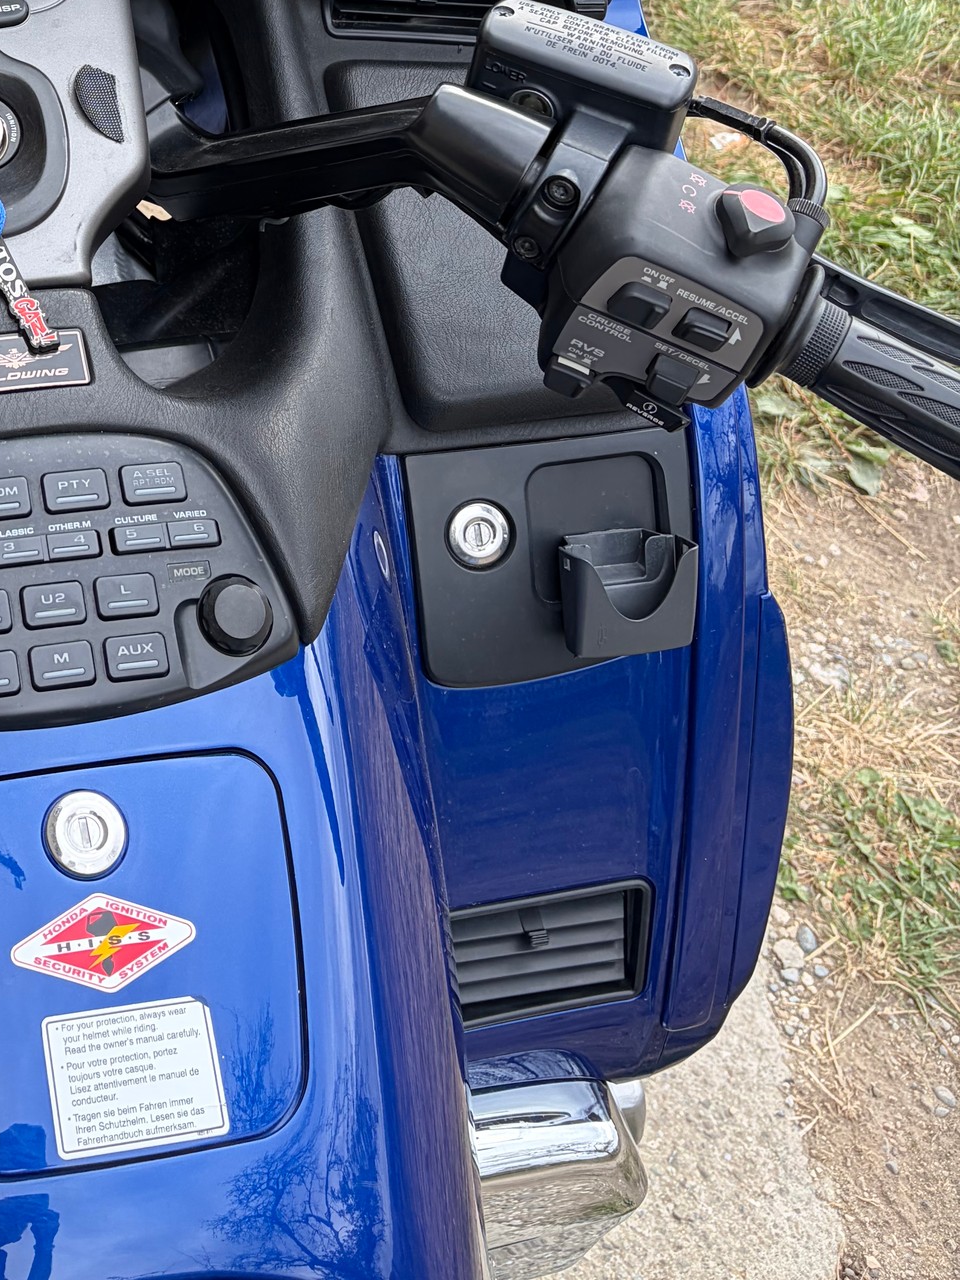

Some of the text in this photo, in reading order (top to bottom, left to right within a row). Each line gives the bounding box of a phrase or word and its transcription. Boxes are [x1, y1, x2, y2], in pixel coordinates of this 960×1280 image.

[566, 31, 614, 51] WARNING
[562, 46, 588, 59] FREIN
[484, 61, 527, 84] LOWER
[618, 56, 647, 72] FLUIDE
[5, 113, 18, 142] IGNITION
[643, 267, 659, 277] ON
[659, 274, 675, 284] OFF
[677, 288, 748, 325] RESUME/ACCEL
[578, 315, 632, 343] CONTROL
[588, 313, 631, 335] CRUISE
[570, 339, 605, 358] RVS
[654, 342, 710, 371] SET/DECEL
[58, 479, 91, 490] PTY
[115, 514, 157, 524] CULTURE
[173, 510, 206, 518] VARIED
[48, 521, 91, 531] OTHER.M
[126, 529, 137, 538] 5
[4, 542, 15, 551] 3
[74, 535, 85, 543] 4
[174, 567, 204, 577] MODE
[121, 585, 131, 594] L
[41, 593, 65, 604] U2
[54, 653, 69, 663] M
[118, 643, 153, 656] AUX
[42, 901, 168, 940] HONDA IGNITION
[34, 942, 169, 983] SECURITY SYSTEM
[61, 1024, 74, 1032] For
[77, 1022, 93, 1031] your
[139, 1010, 166, 1021] always
[168, 1007, 186, 1015] wear
[63, 1035, 80, 1045] your
[83, 1031, 110, 1041] helmet
[112, 1026, 132, 1036] while
[64, 1047, 86, 1055] Read
[89, 1043, 101, 1051] the
[136, 1034, 164, 1044] manual
[66, 1062, 85, 1070] Pour
[88, 1058, 107, 1067] votre
[154, 1048, 178, 1059] portez
[69, 1072, 100, 1084] toujours
[103, 1067, 122, 1077] votre
[70, 1085, 91, 1094] Lisez
[94, 1077, 147, 1091] attentivement
[159, 1069, 188, 1080] manuel
[73, 1097, 193, 1123] Tragen beim Fahren immer
[76, 1125, 96, 1134] Ihren
[150, 1113, 175, 1122] Lesen
[77, 1130, 144, 1146] Fahrerhandbuch
